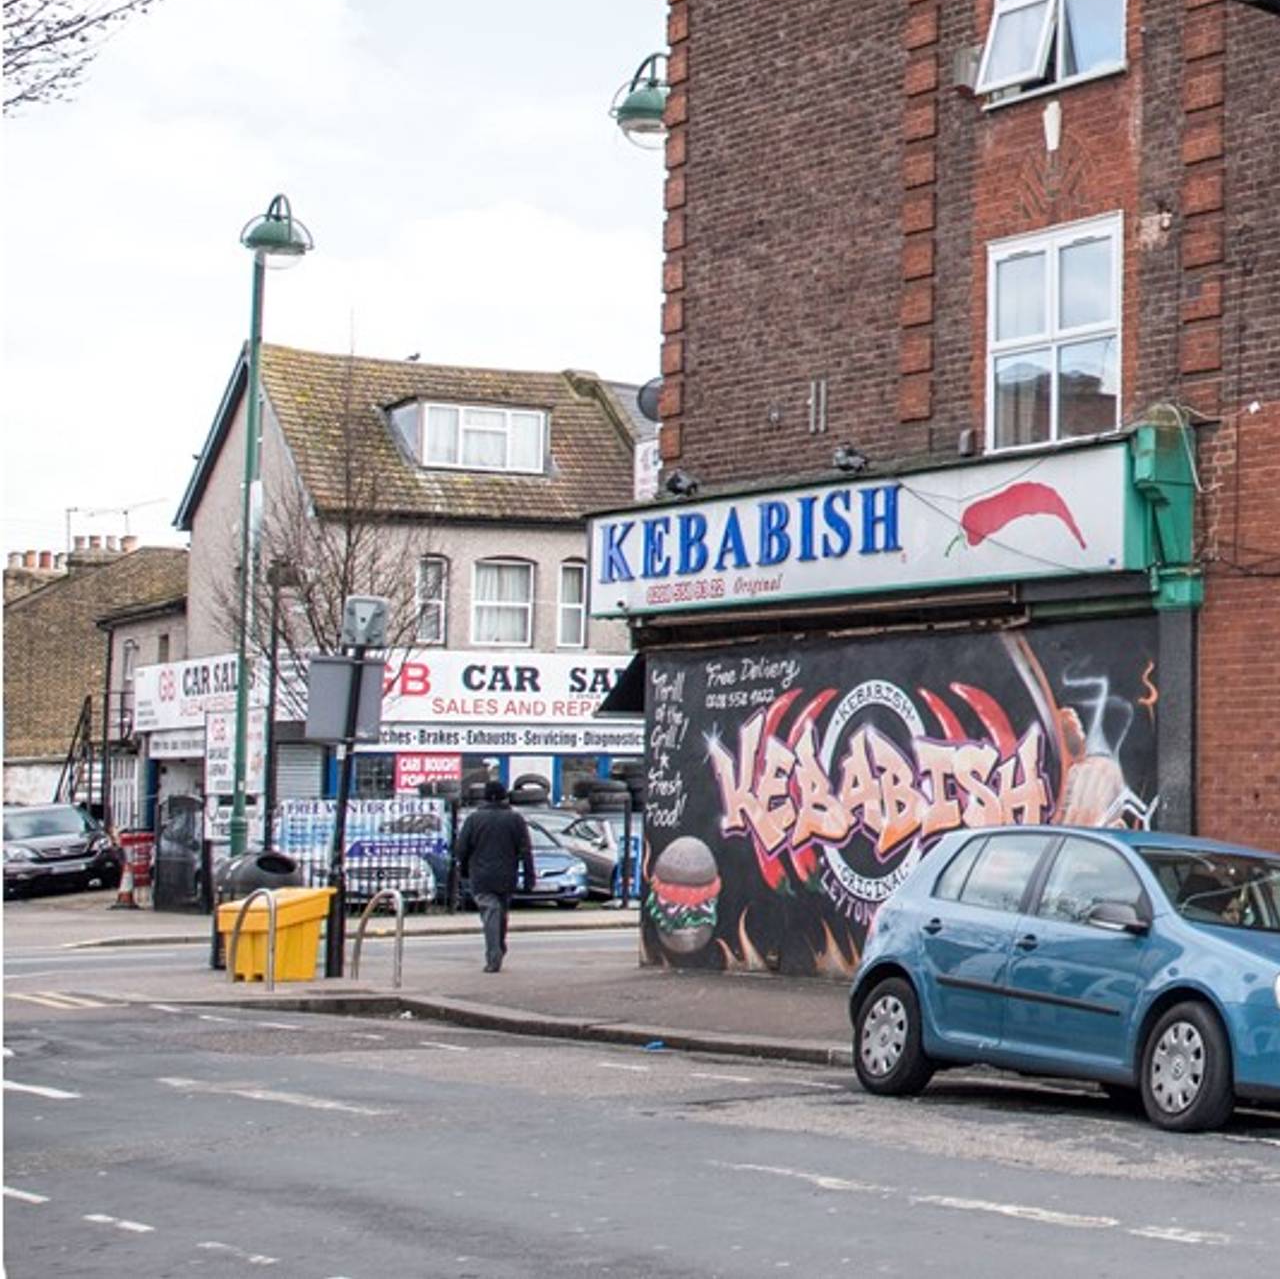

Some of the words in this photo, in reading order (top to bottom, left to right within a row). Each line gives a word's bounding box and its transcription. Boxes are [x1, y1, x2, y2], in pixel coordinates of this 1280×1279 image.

[599, 482, 903, 585] KEBABISH
[733, 572, 784, 597] Original
[183, 665, 211, 697] CAR
[462, 664, 541, 693] CAR
[705, 662, 737, 688] Free
[431, 697, 498, 715] SALES
[503, 699, 547, 717] AND
[838, 683, 916, 721] KEBABISH
[419, 729, 460, 745] Brakes
[466, 729, 517, 745] Exhausts
[523, 729, 577, 747] Servicing
[708, 709, 1054, 864] KEBABISH
[326, 802, 385, 815] WNTER
